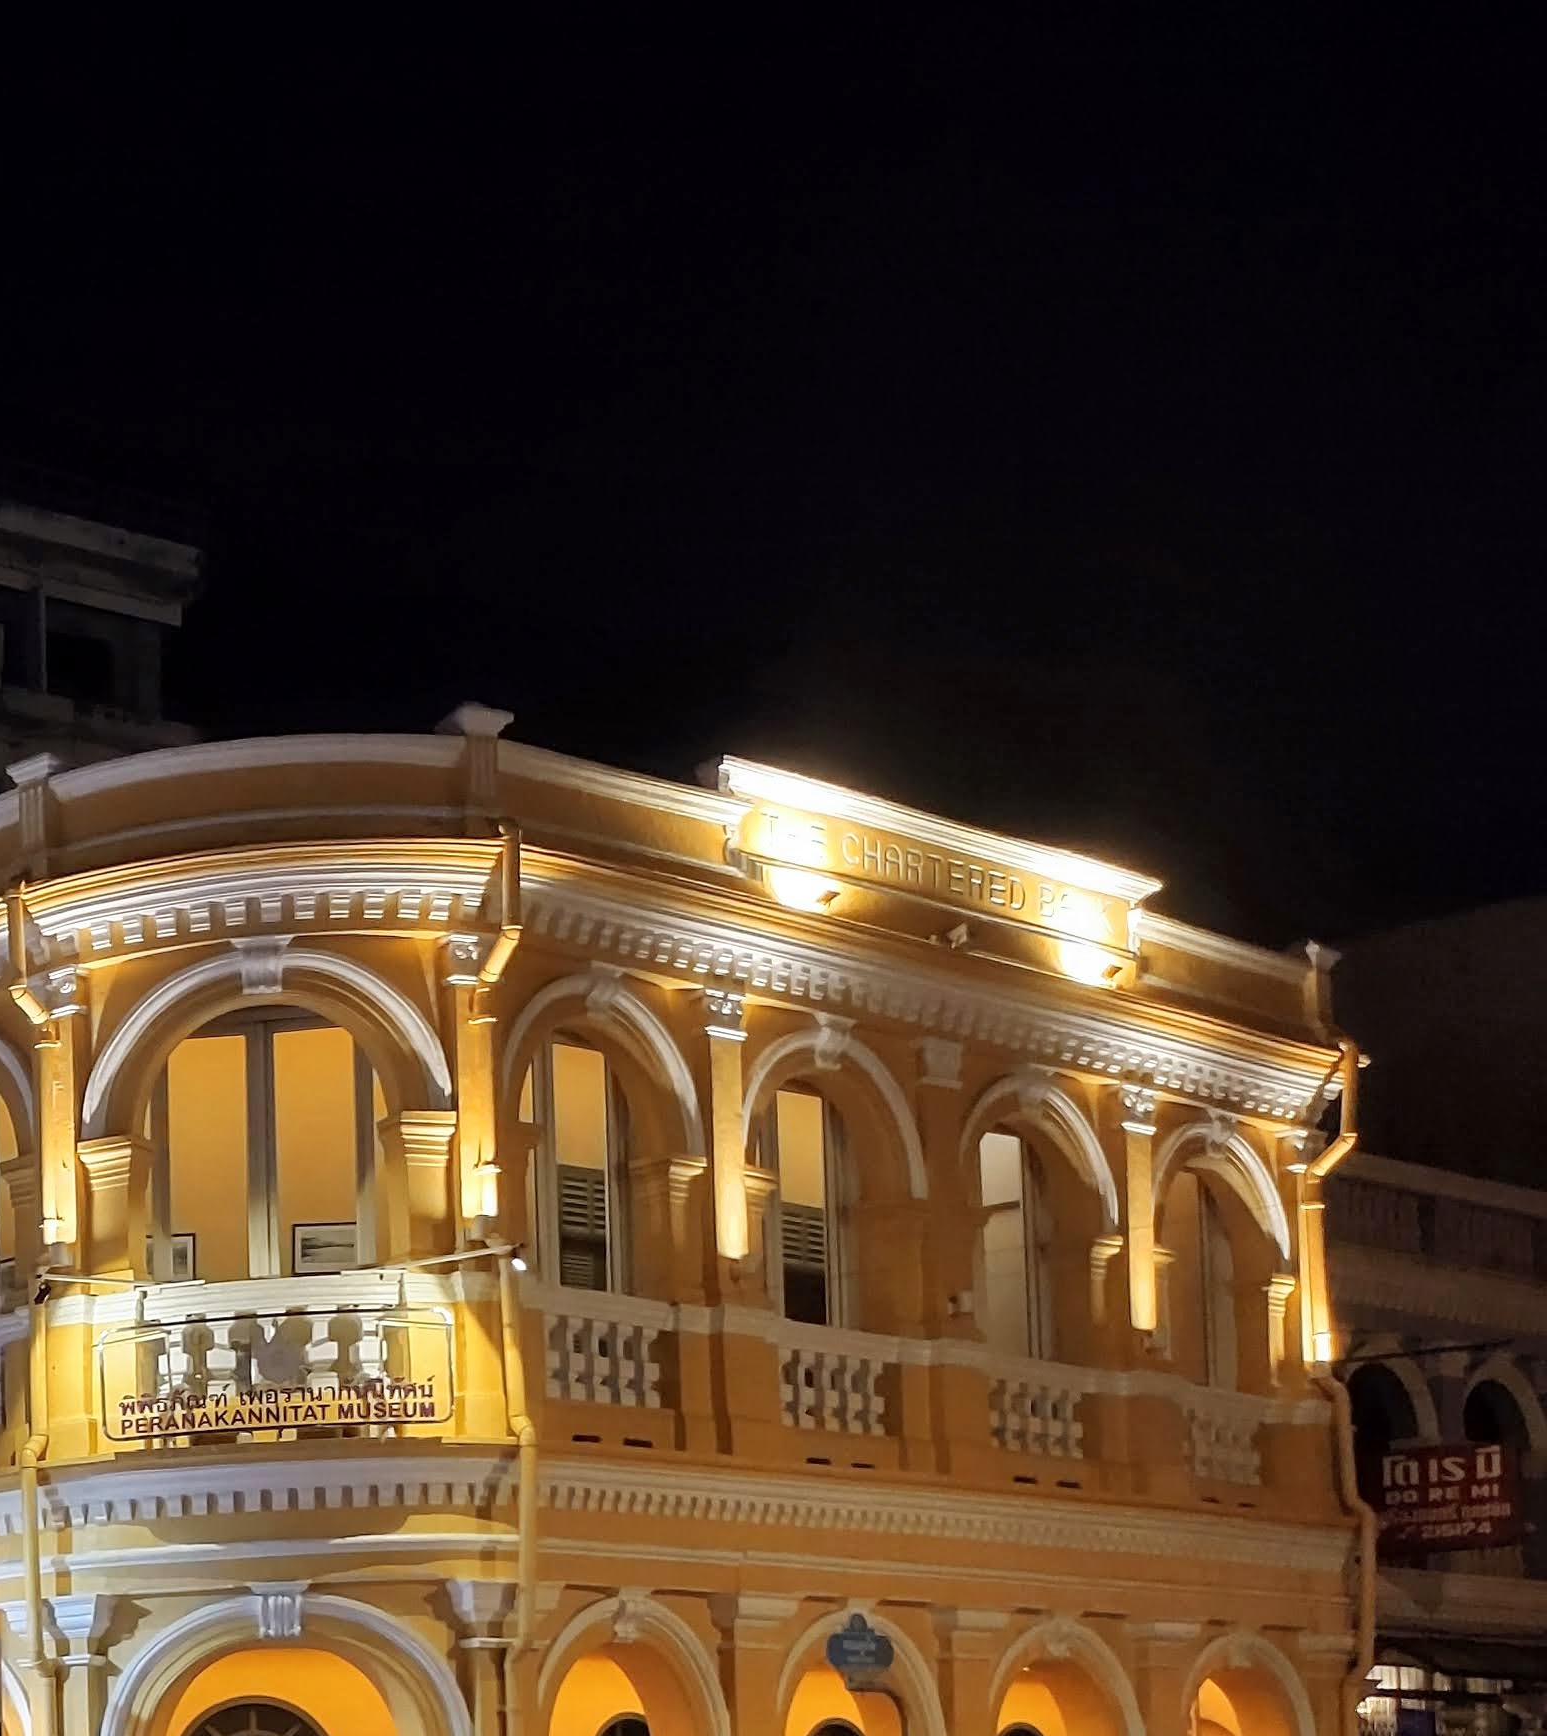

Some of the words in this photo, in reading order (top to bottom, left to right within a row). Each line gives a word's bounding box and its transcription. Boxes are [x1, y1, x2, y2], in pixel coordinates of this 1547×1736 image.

[759, 810, 828, 861] TE
[839, 832, 1026, 911] CHARTERED
[1038, 884, 1116, 937] BA
[120, 1403, 331, 1435] PERANAKANNITAT
[337, 1401, 436, 1420] MUSEUM
[1384, 1488, 1419, 1506] DO
[1427, 1486, 1460, 1503] RE
[1470, 1483, 1500, 1499] MI
